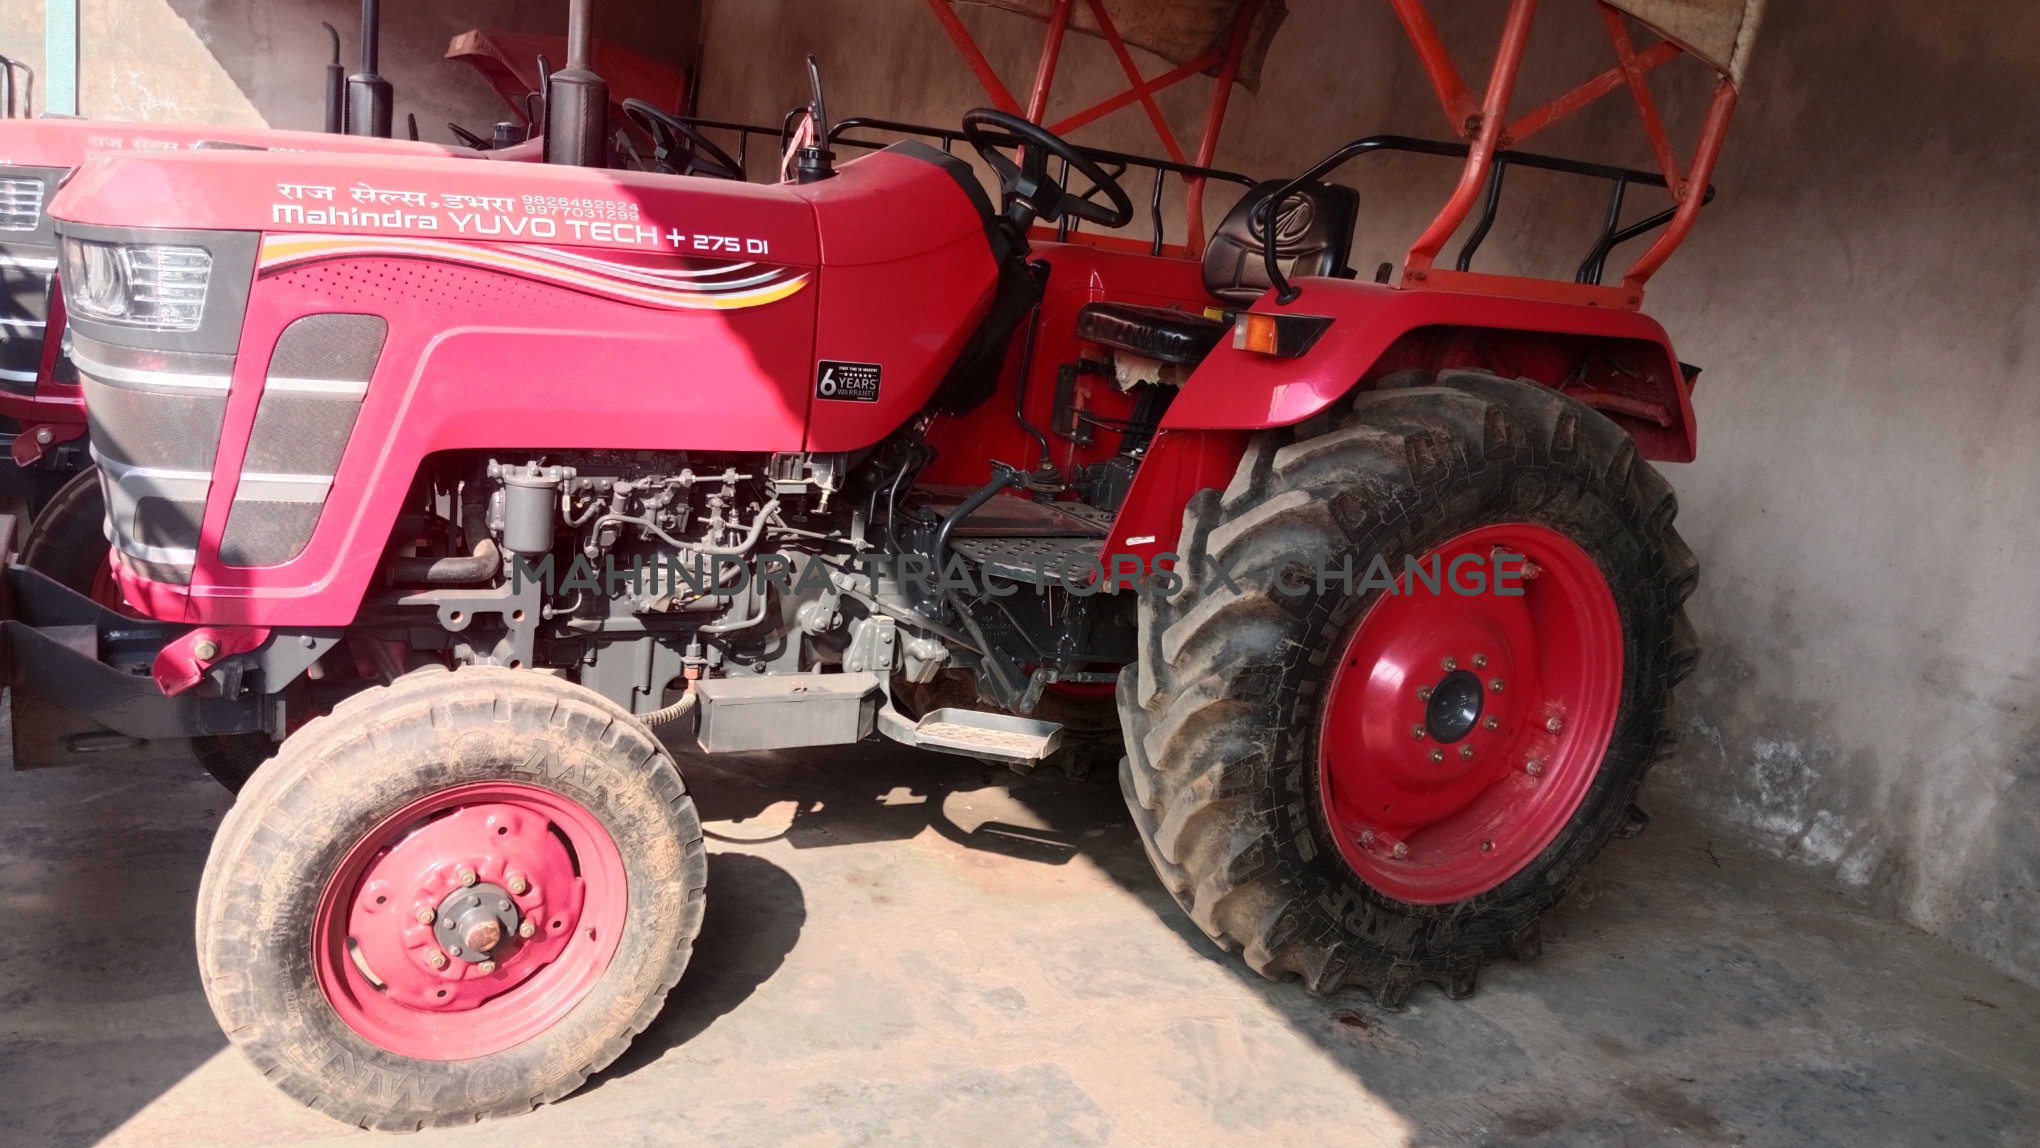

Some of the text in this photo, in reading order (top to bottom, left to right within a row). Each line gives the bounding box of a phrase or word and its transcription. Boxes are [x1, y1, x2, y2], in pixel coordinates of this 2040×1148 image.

[277, 183, 336, 201] राज
[521, 194, 639, 212] 9826482524
[272, 203, 438, 230] Mahindra
[447, 211, 557, 238] YUVO
[565, 219, 658, 245] TECH
[693, 234, 740, 252] 275
[746, 239, 768, 254] DI
[820, 368, 877, 396] 6 YEARS
[837, 388, 876, 397] WARRANTY
